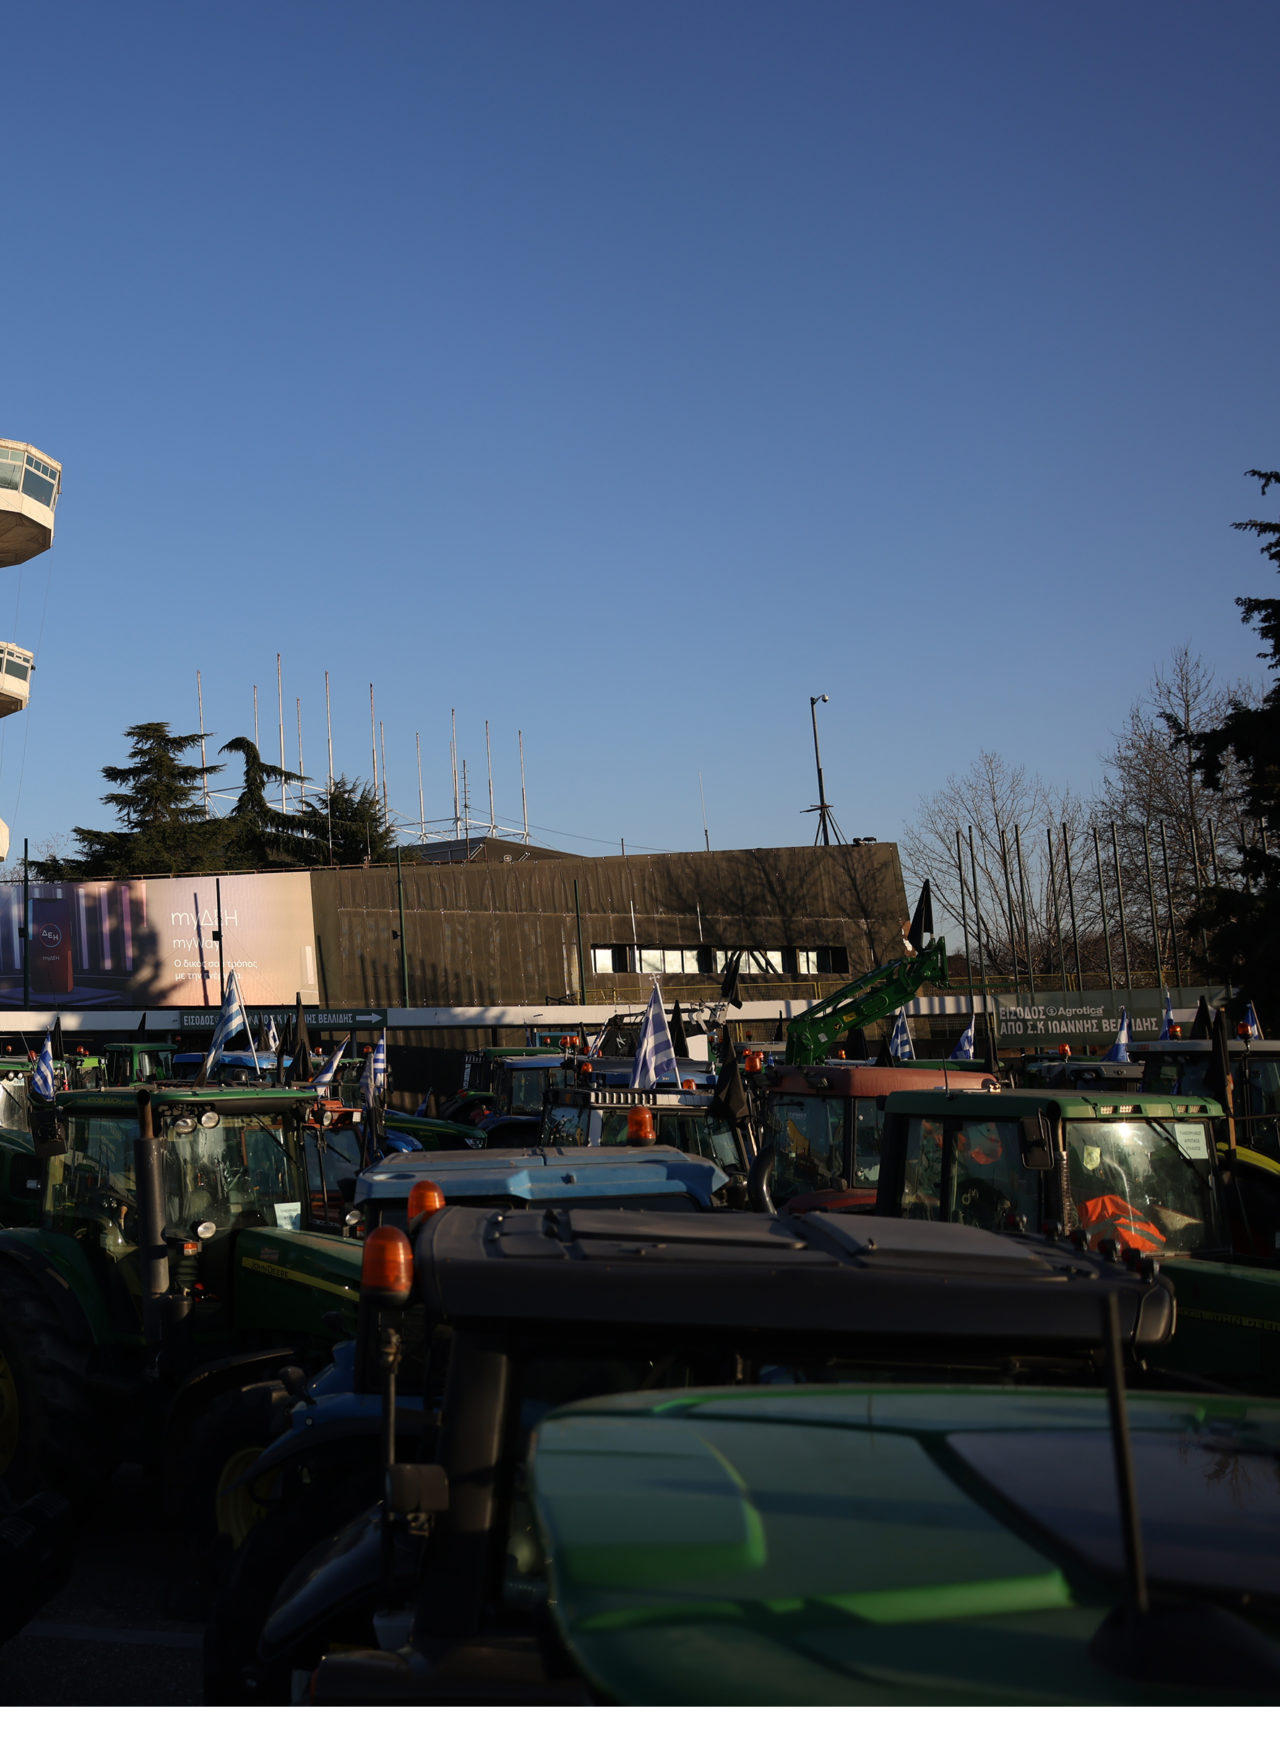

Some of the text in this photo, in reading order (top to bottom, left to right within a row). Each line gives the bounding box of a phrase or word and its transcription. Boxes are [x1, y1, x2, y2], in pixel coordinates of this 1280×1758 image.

[41, 929, 59, 941] ΔΕΗ
[173, 937, 220, 952] myWay
[227, 960, 258, 970] τρόπος
[184, 1015, 215, 1026] ΕΙΣΟΔΟΣ
[318, 1013, 353, 1023] ΒΕΛΛΙΔΗΣ
[999, 1005, 1104, 1020] ΕΙΣΟΔΟΣ Agrotica
[1000, 1021, 1024, 1035] ΑΠΟ
[1048, 1019, 1099, 1034] ΙΩΑΝΝΗΣ
